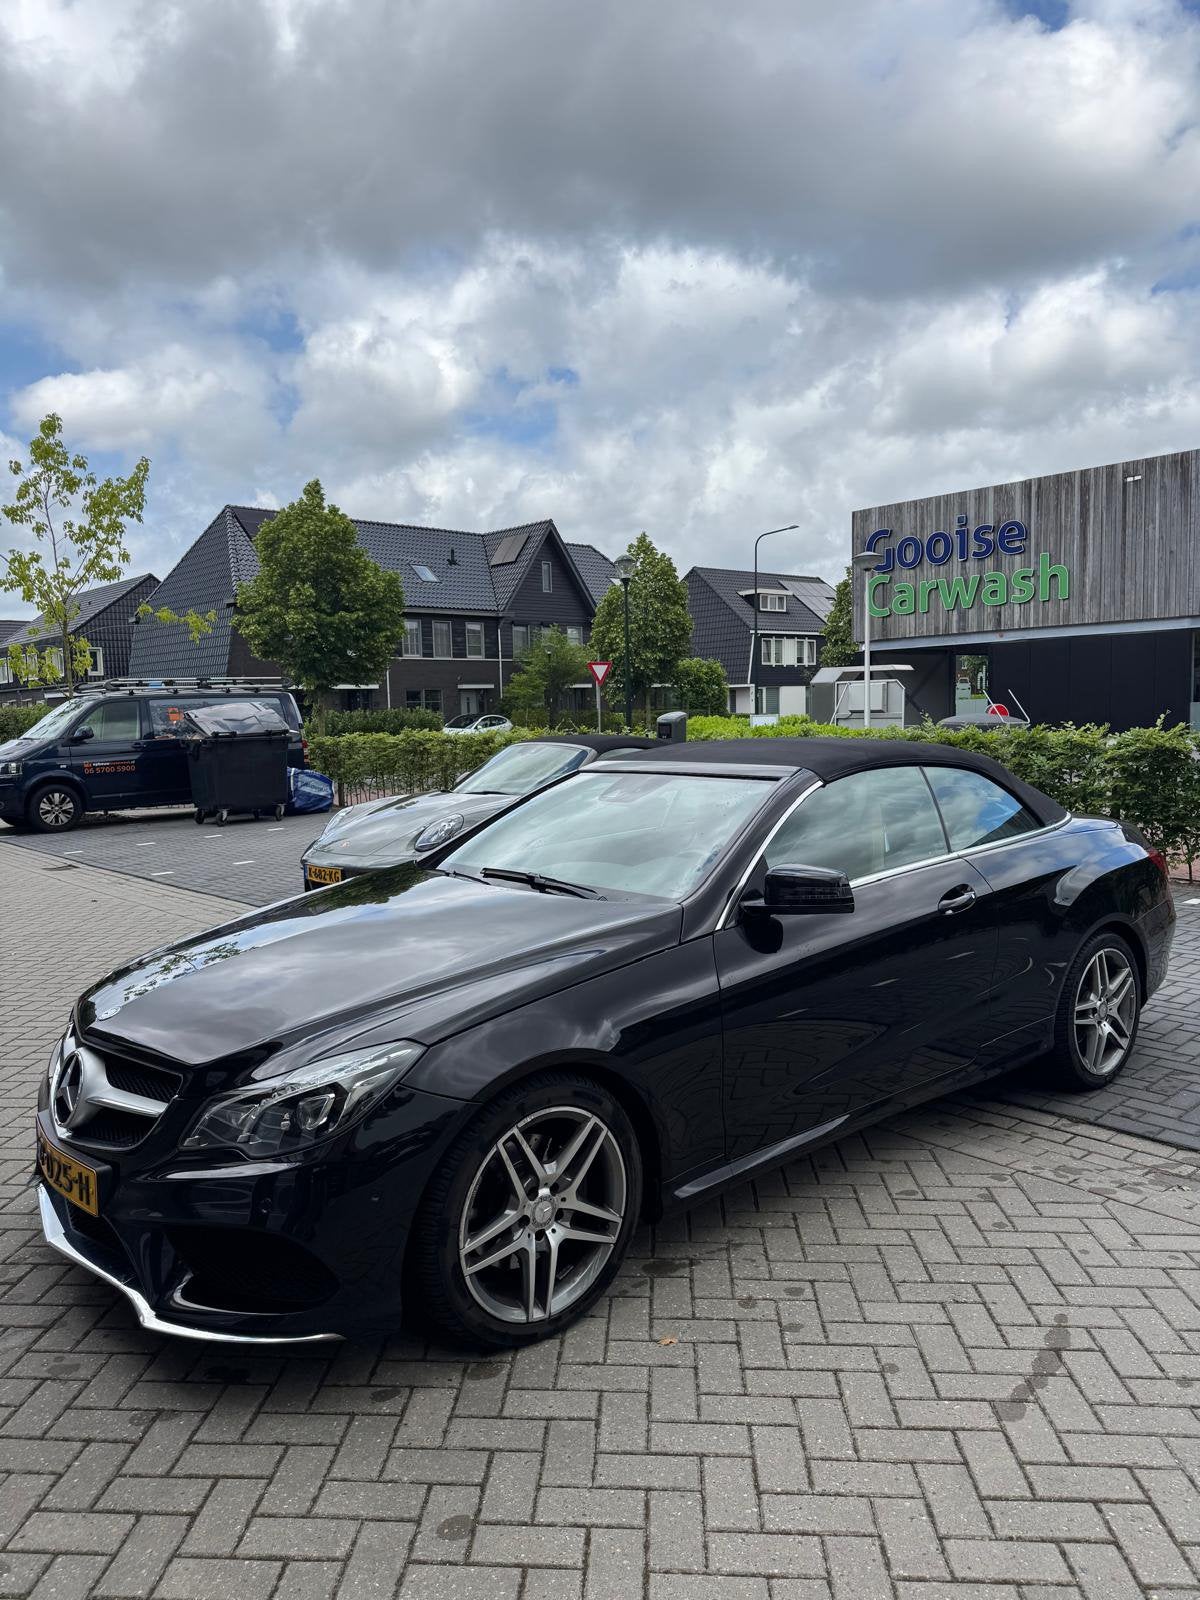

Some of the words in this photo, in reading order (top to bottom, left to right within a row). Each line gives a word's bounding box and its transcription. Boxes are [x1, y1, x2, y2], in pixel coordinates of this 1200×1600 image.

[865, 514, 1027, 573] Gooise
[866, 552, 1070, 618] Carwash
[95, 766, 116, 774] 5700
